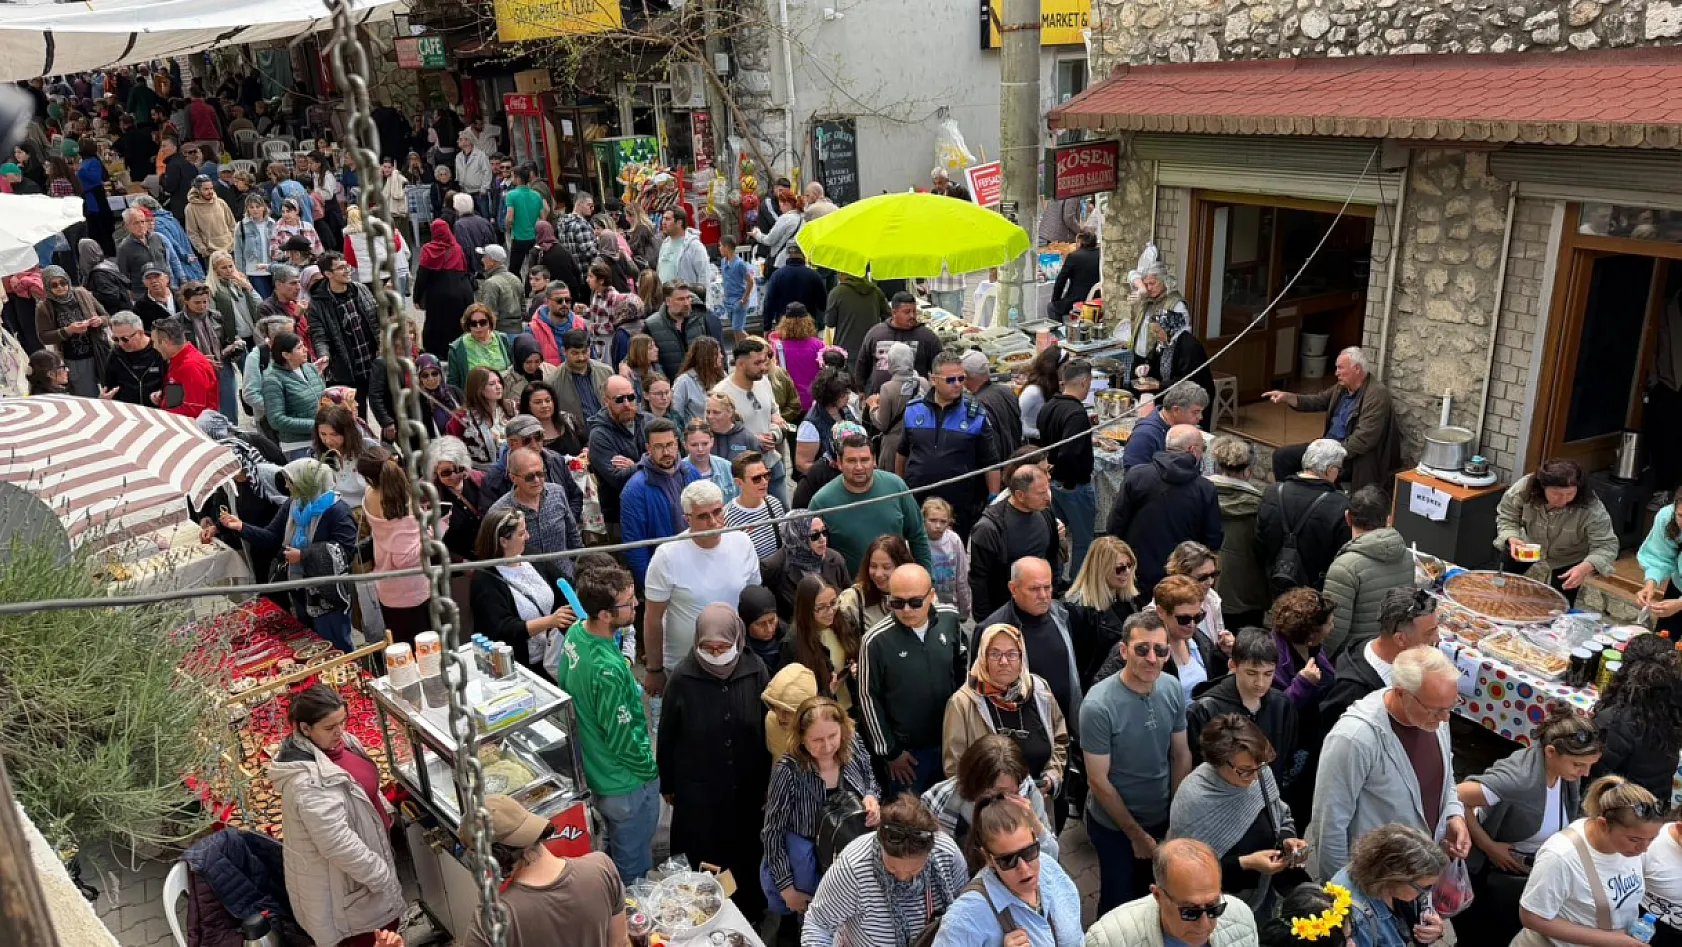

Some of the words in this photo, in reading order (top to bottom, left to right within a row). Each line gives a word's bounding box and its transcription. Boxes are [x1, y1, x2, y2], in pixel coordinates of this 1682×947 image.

[1042, 13, 1079, 28] MARKET
[1081, 12, 1088, 27] &
[418, 38, 442, 56] CAFE
[1057, 149, 1114, 177] KÖŞEM
[1058, 173, 1085, 190] BERBER
